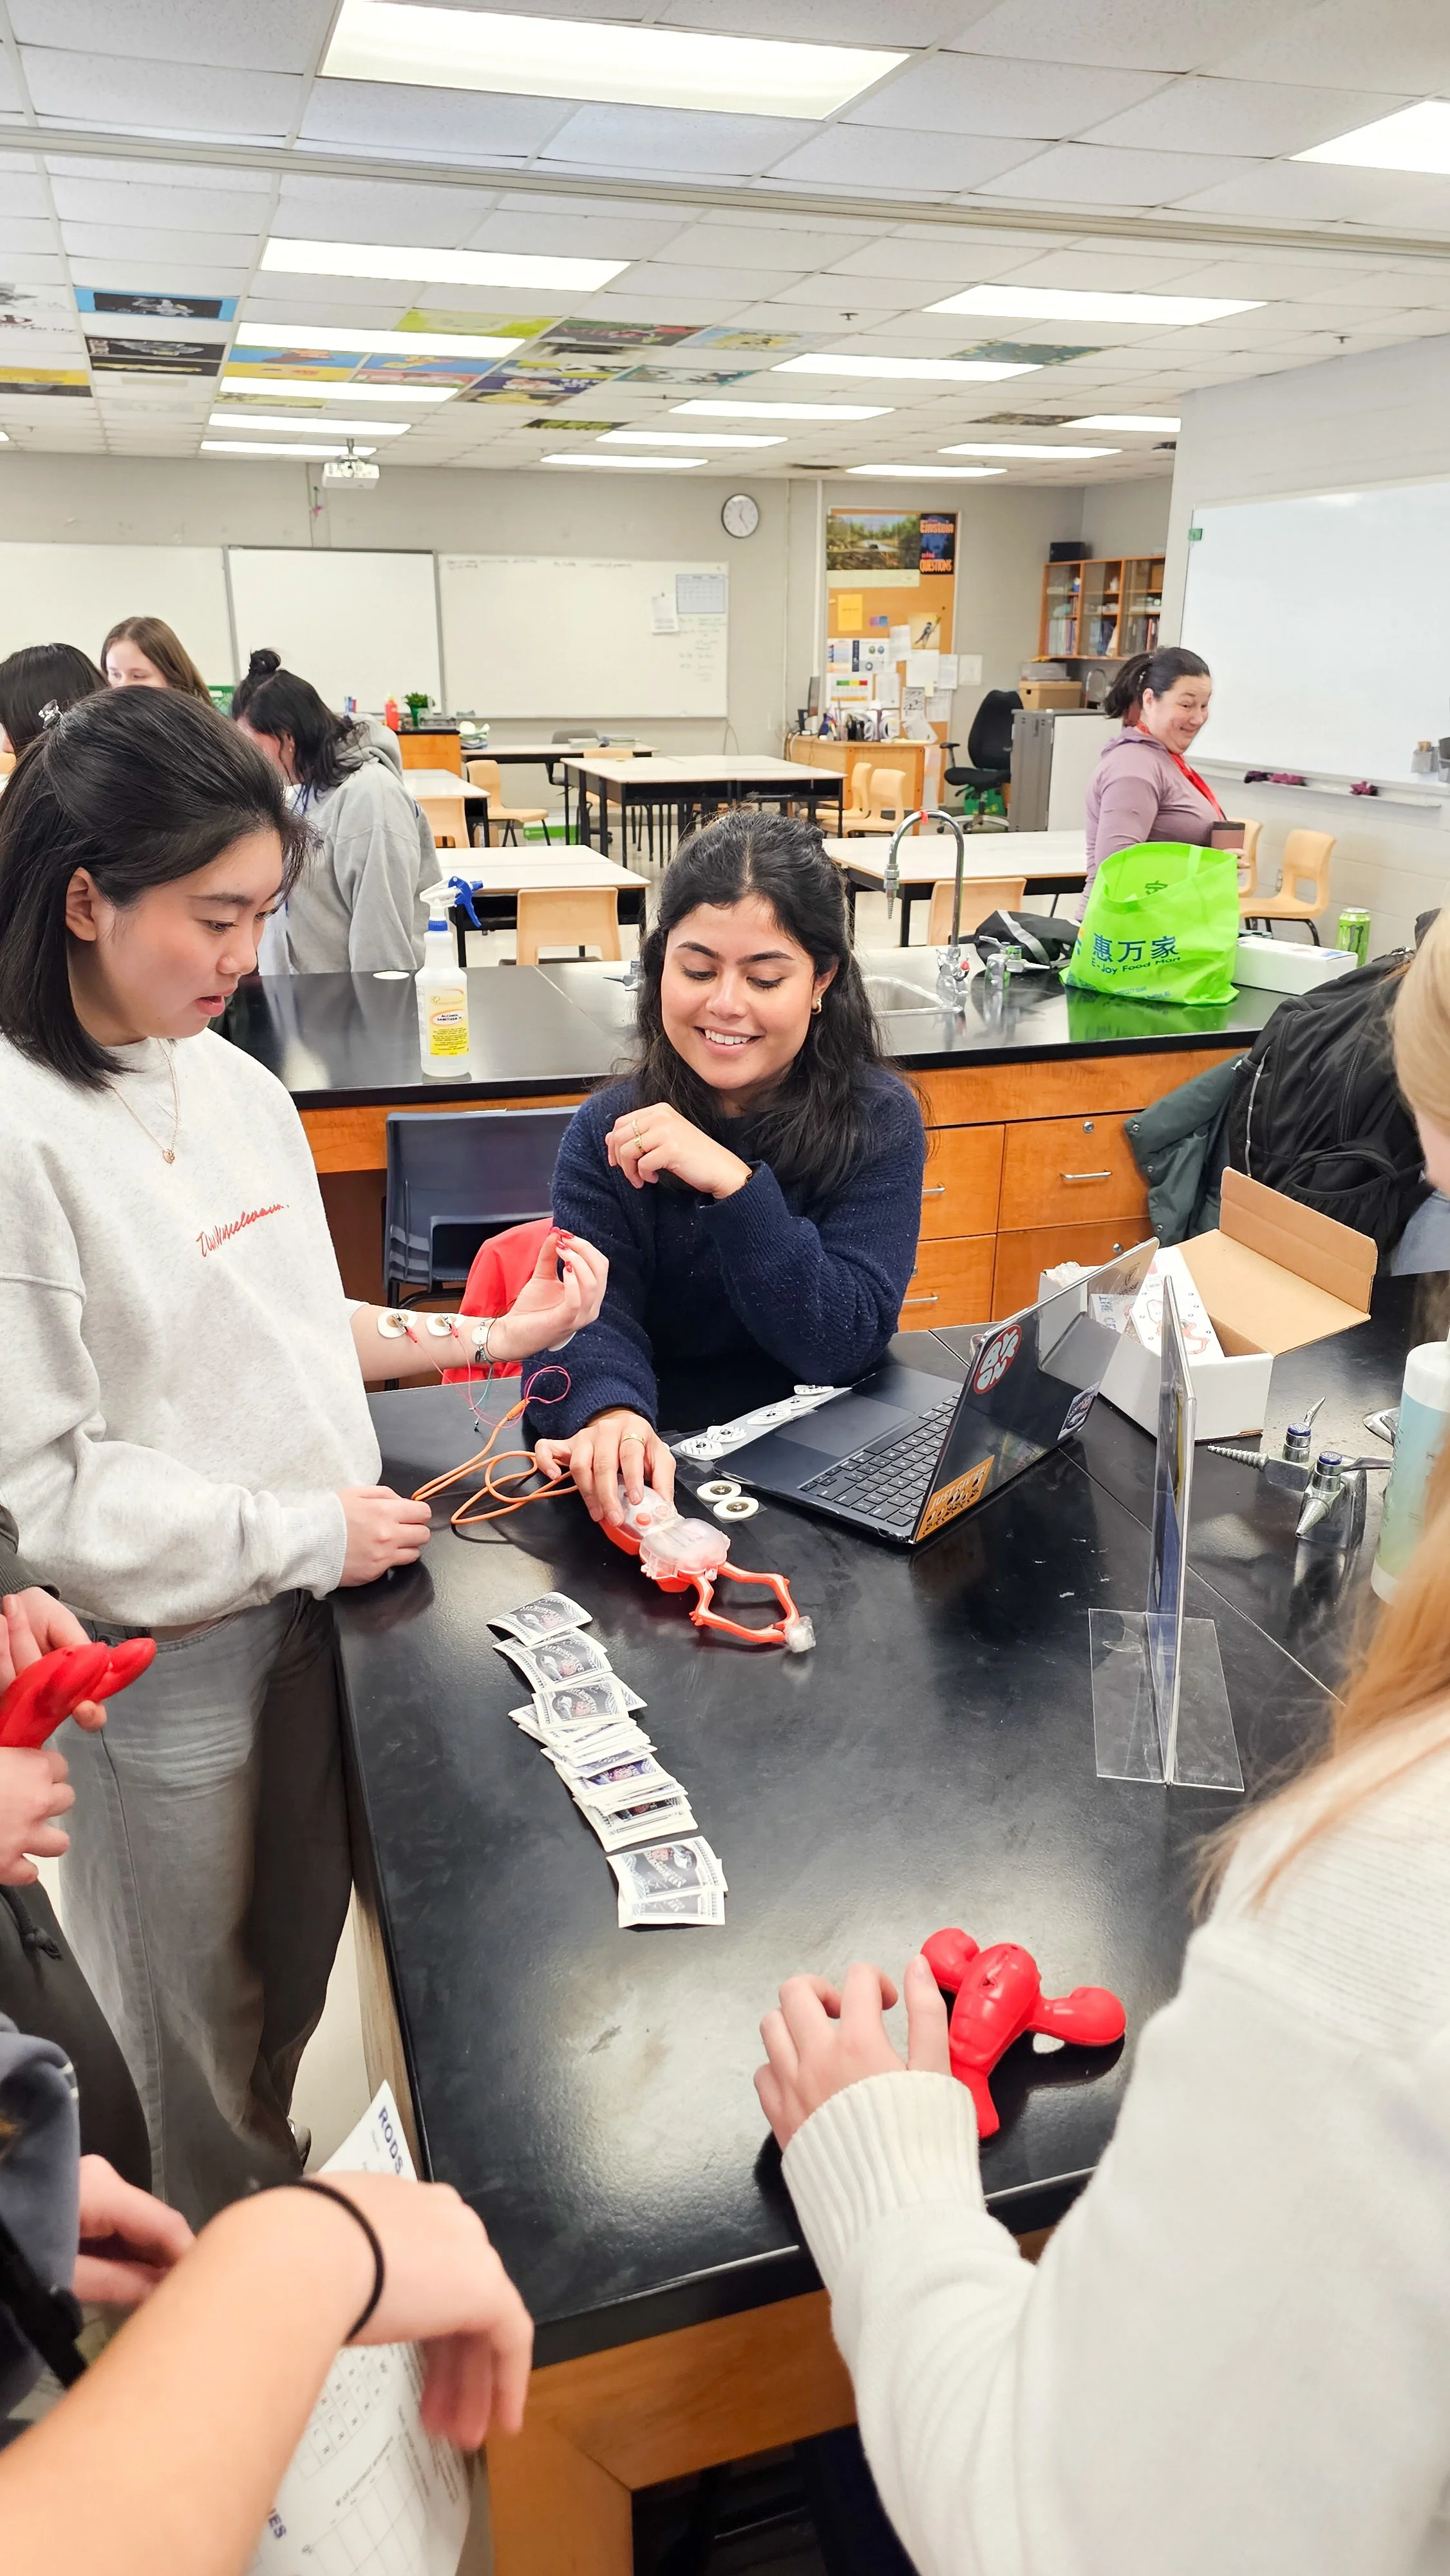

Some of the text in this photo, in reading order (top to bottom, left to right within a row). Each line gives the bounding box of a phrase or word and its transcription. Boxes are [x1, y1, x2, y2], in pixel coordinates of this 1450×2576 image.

[920, 519, 954, 533] Einstein
[919, 559, 952, 573] QUESTIONS
[1092, 933, 1180, 963] 惠万家
[1091, 956, 1182, 975] E-Joy Food Mart
[928, 1485, 956, 1513] JUST
[379, 2106, 403, 2175] RODS
